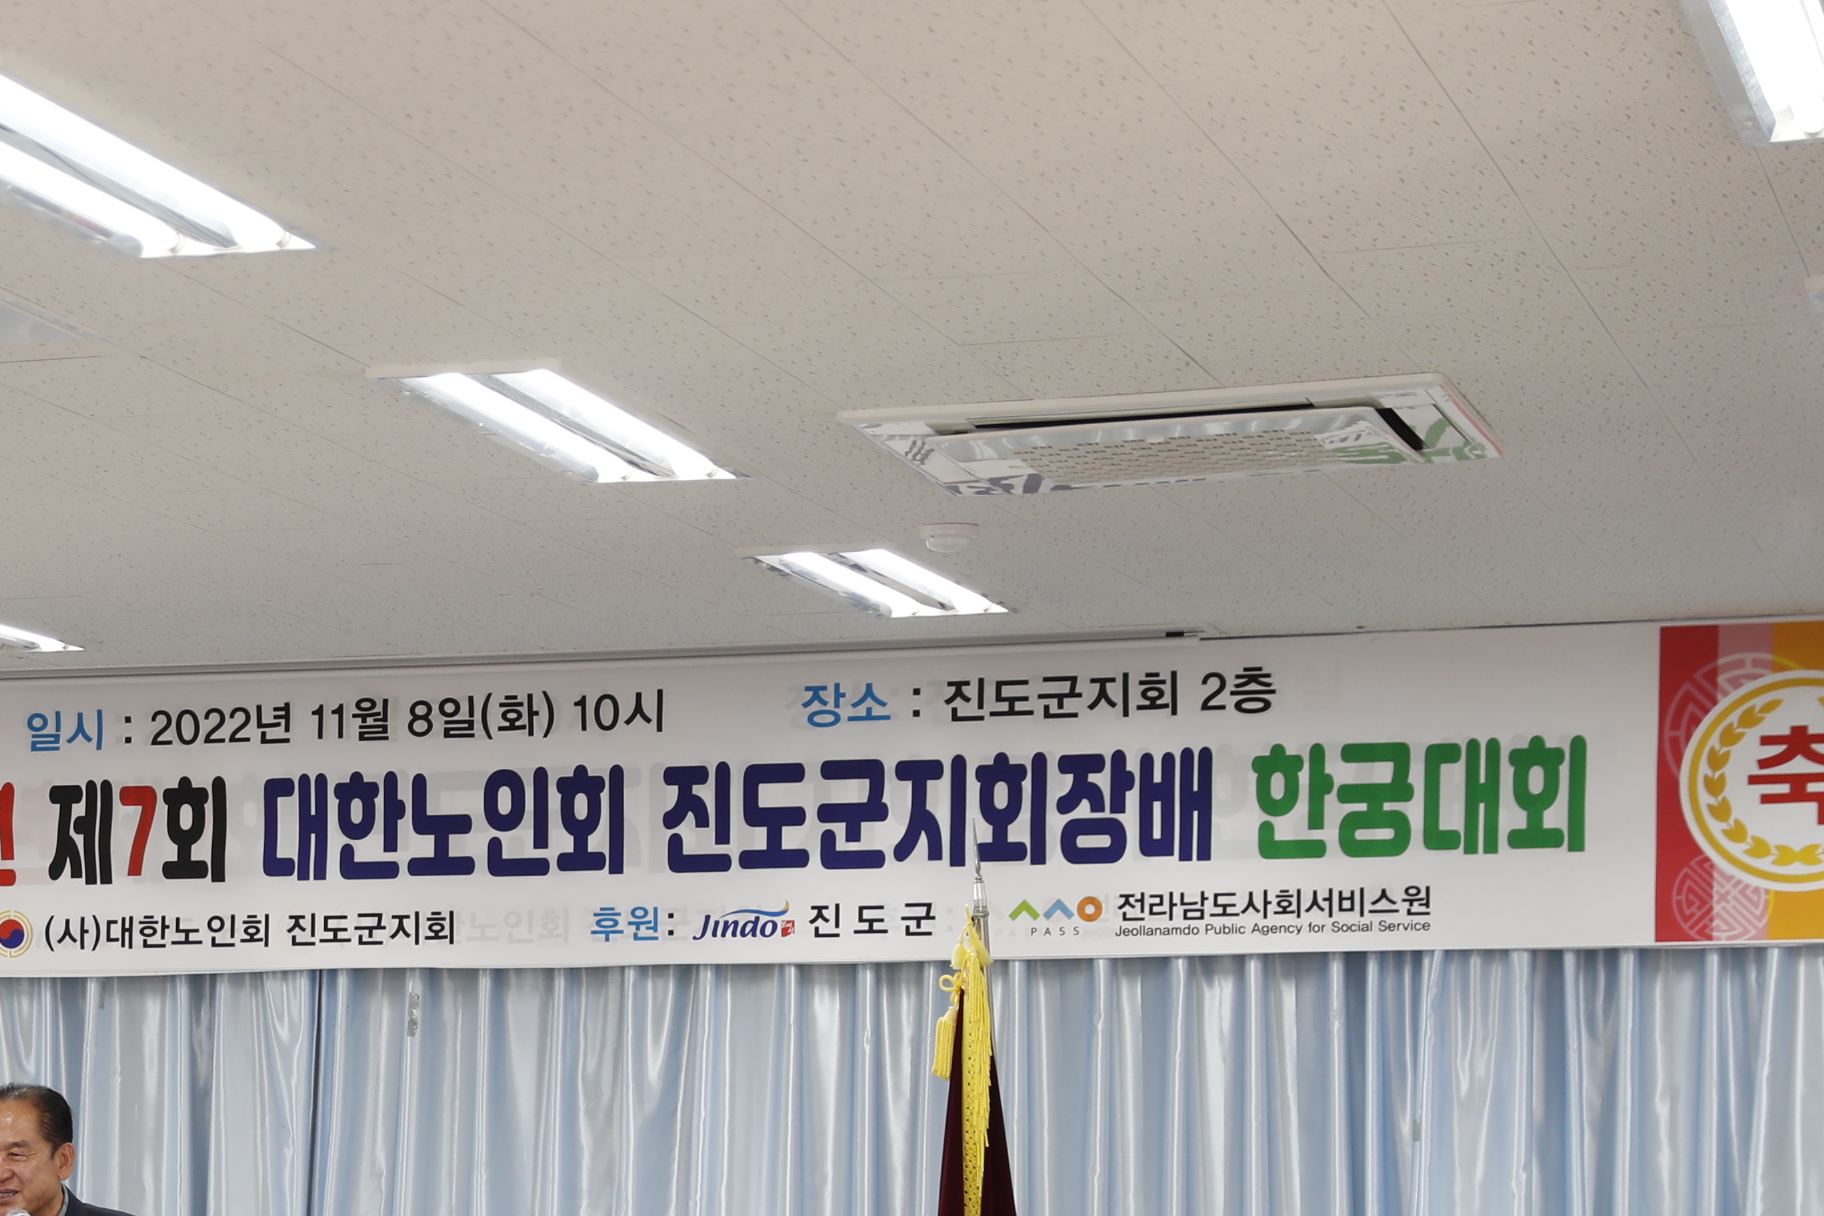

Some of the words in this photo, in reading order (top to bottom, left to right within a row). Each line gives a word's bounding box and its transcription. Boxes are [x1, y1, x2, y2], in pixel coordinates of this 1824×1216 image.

[801, 682, 891, 728] 장소
[943, 670, 1178, 722] 진도군지회
[1200, 666, 1277, 714] 2층
[26, 709, 104, 752] 일시
[150, 701, 291, 746] 2022년
[311, 697, 390, 742] 11월
[407, 690, 555, 740] 8일(화)
[573, 688, 664, 733] 10시
[47, 775, 228, 886] 제7회
[262, 763, 625, 882] 대한노인회
[662, 746, 1214, 874] 진도군지회장배
[1251, 734, 1588, 860] 한궁대회
[1117, 885, 1432, 922] 전라남도사회서비스원
[44, 912, 270, 952] (사)대한노인회
[286, 909, 455, 947] 진도군지회
[692, 914, 780, 941] Jindo
[1115, 925, 1200, 937] Jeollanamdo
[1204, 923, 1246, 935] Public
[1251, 922, 1304, 937] Agency
[1308, 921, 1327, 934] for
[1331, 920, 1373, 934] Social
[1378, 919, 1432, 933] Service
